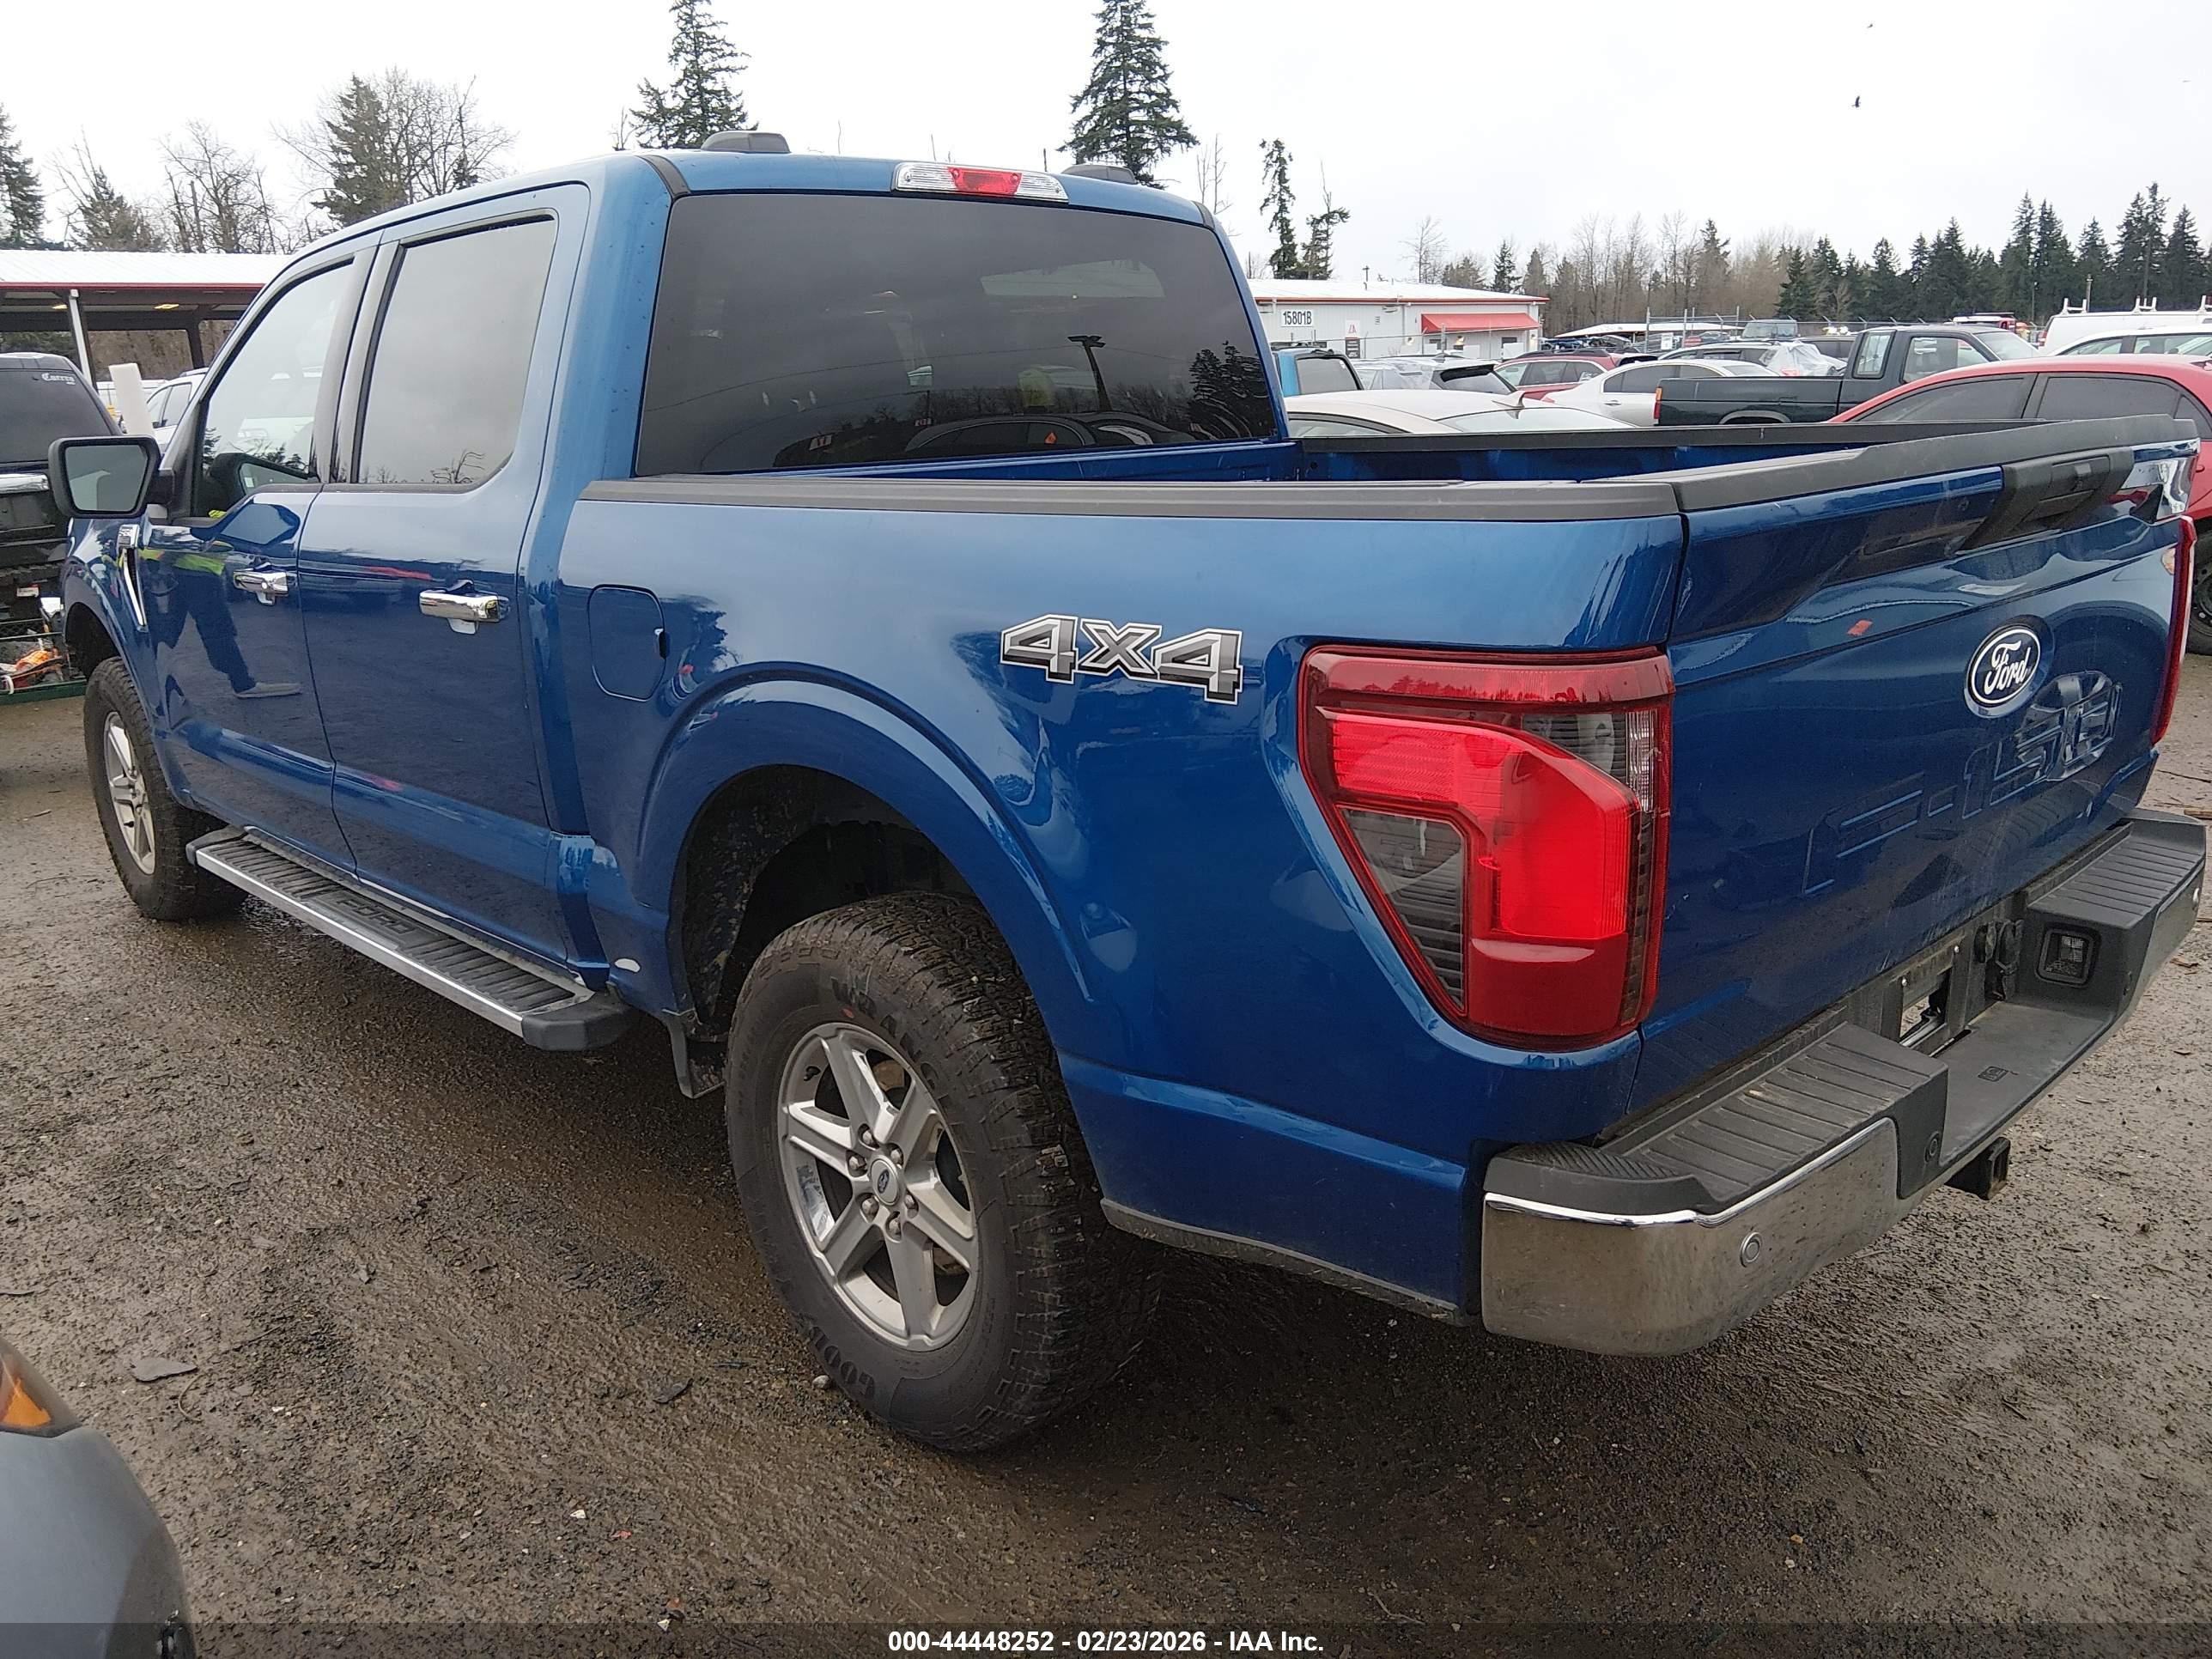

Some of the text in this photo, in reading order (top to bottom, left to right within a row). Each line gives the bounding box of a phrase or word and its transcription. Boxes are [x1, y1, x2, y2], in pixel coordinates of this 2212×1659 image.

[1283, 310, 1312, 325] 15801B
[1984, 639, 2030, 696] Ford
[1802, 683, 2123, 895] F-150
